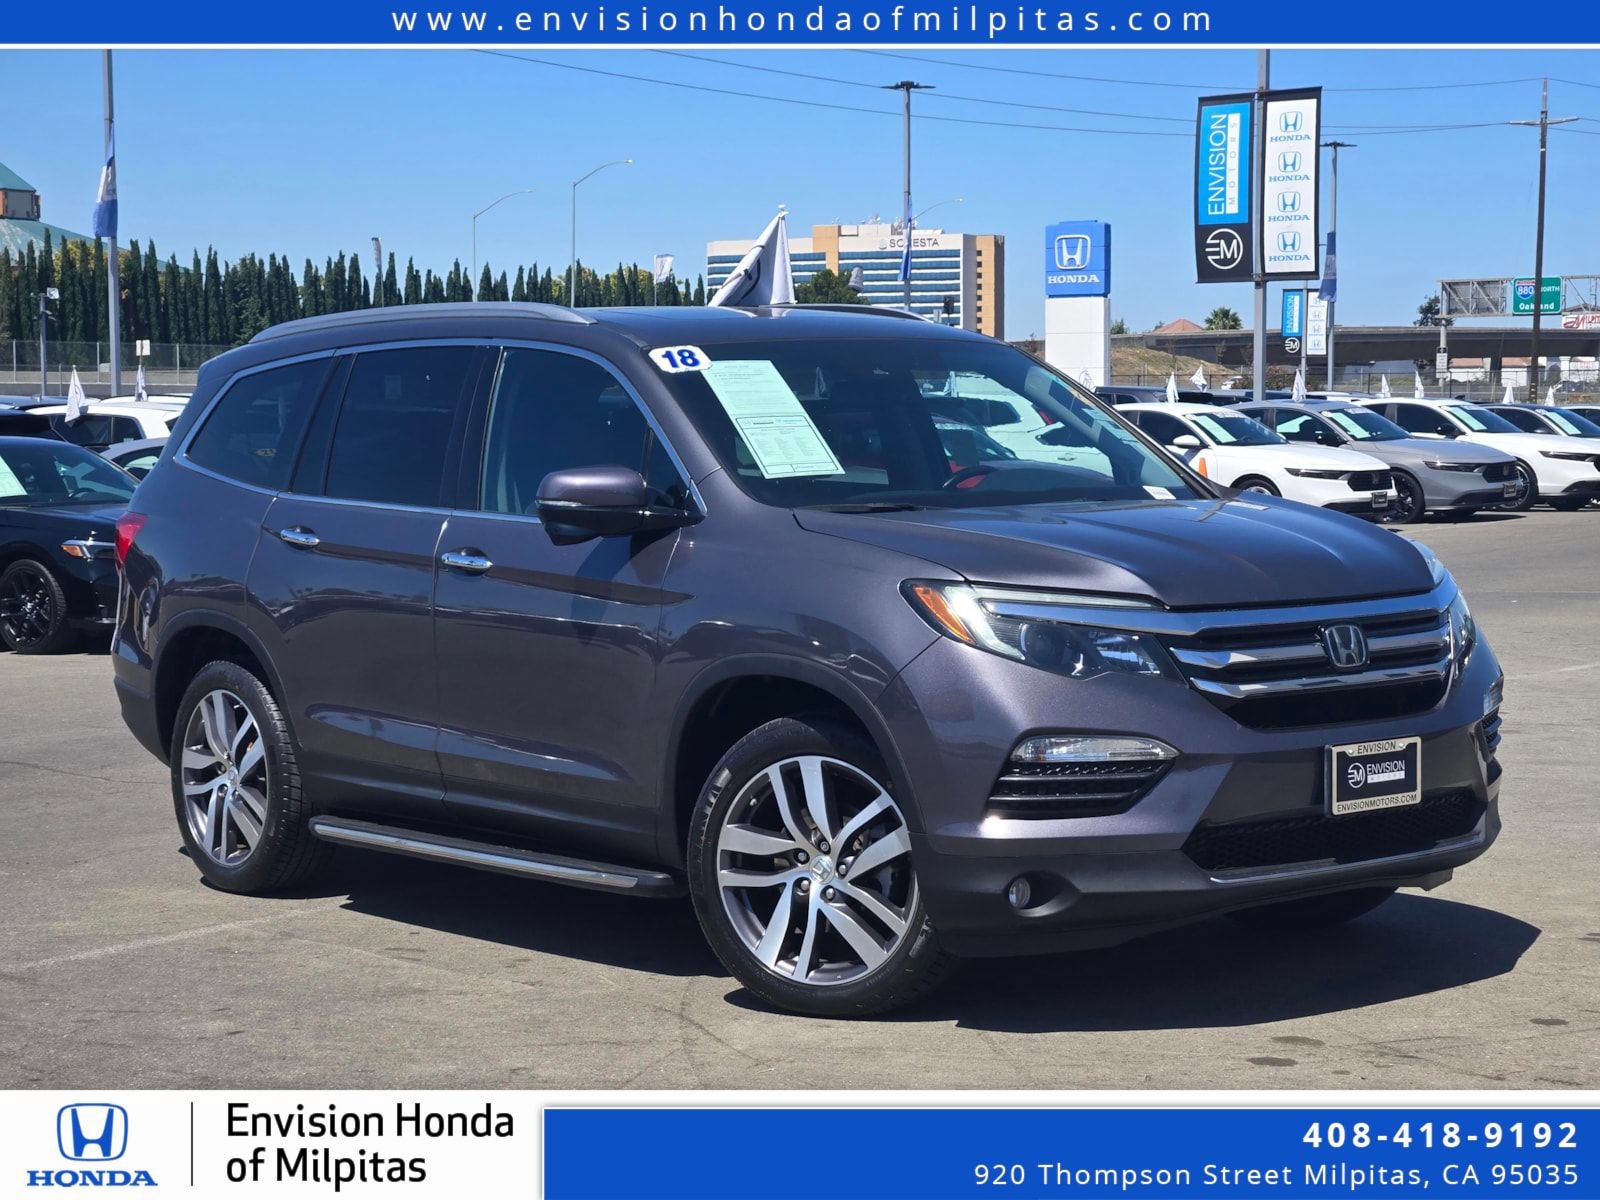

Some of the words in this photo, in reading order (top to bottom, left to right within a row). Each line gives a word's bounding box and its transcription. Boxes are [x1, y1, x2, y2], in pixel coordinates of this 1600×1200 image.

[1270, 134, 1311, 143] HONDA
[1208, 114, 1227, 215] ENVISION
[1229, 122, 1238, 206] MOTORS
[1268, 174, 1311, 182] HONDA
[1268, 214, 1311, 222] HONDA
[889, 238, 940, 248] SOESTA
[1268, 254, 1311, 262] HONDA
[1048, 274, 1100, 284] HONDA
[1517, 286, 1534, 295] 880
[661, 349, 700, 368] 18
[1357, 741, 1397, 755] ENVISION
[1366, 760, 1406, 775] ENVISION
[1336, 793, 1417, 813] ENVISIONMOTORS.COM
